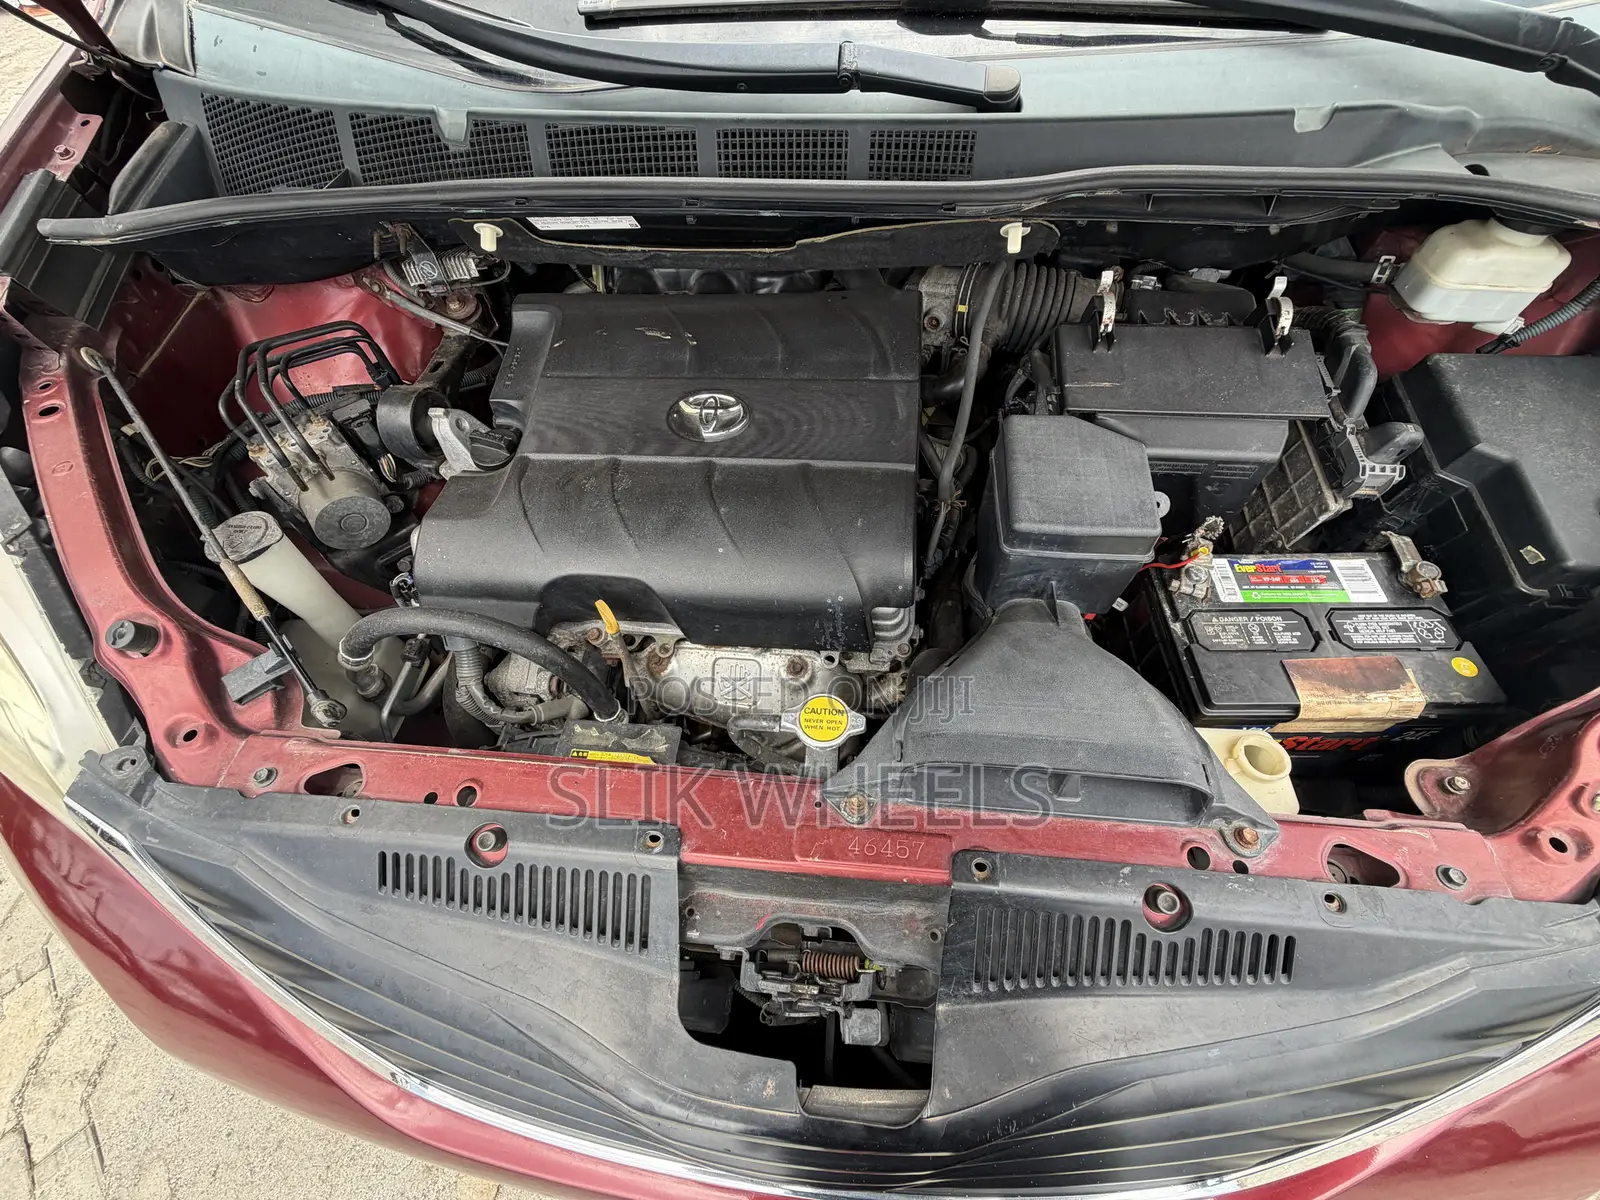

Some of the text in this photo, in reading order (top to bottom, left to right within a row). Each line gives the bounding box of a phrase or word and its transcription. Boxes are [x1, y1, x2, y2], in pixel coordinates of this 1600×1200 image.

[1235, 564, 1282, 573] EverStart
[804, 707, 845, 716] CAUTION
[1276, 735, 1381, 750] Start
[848, 836, 925, 860] 46457
